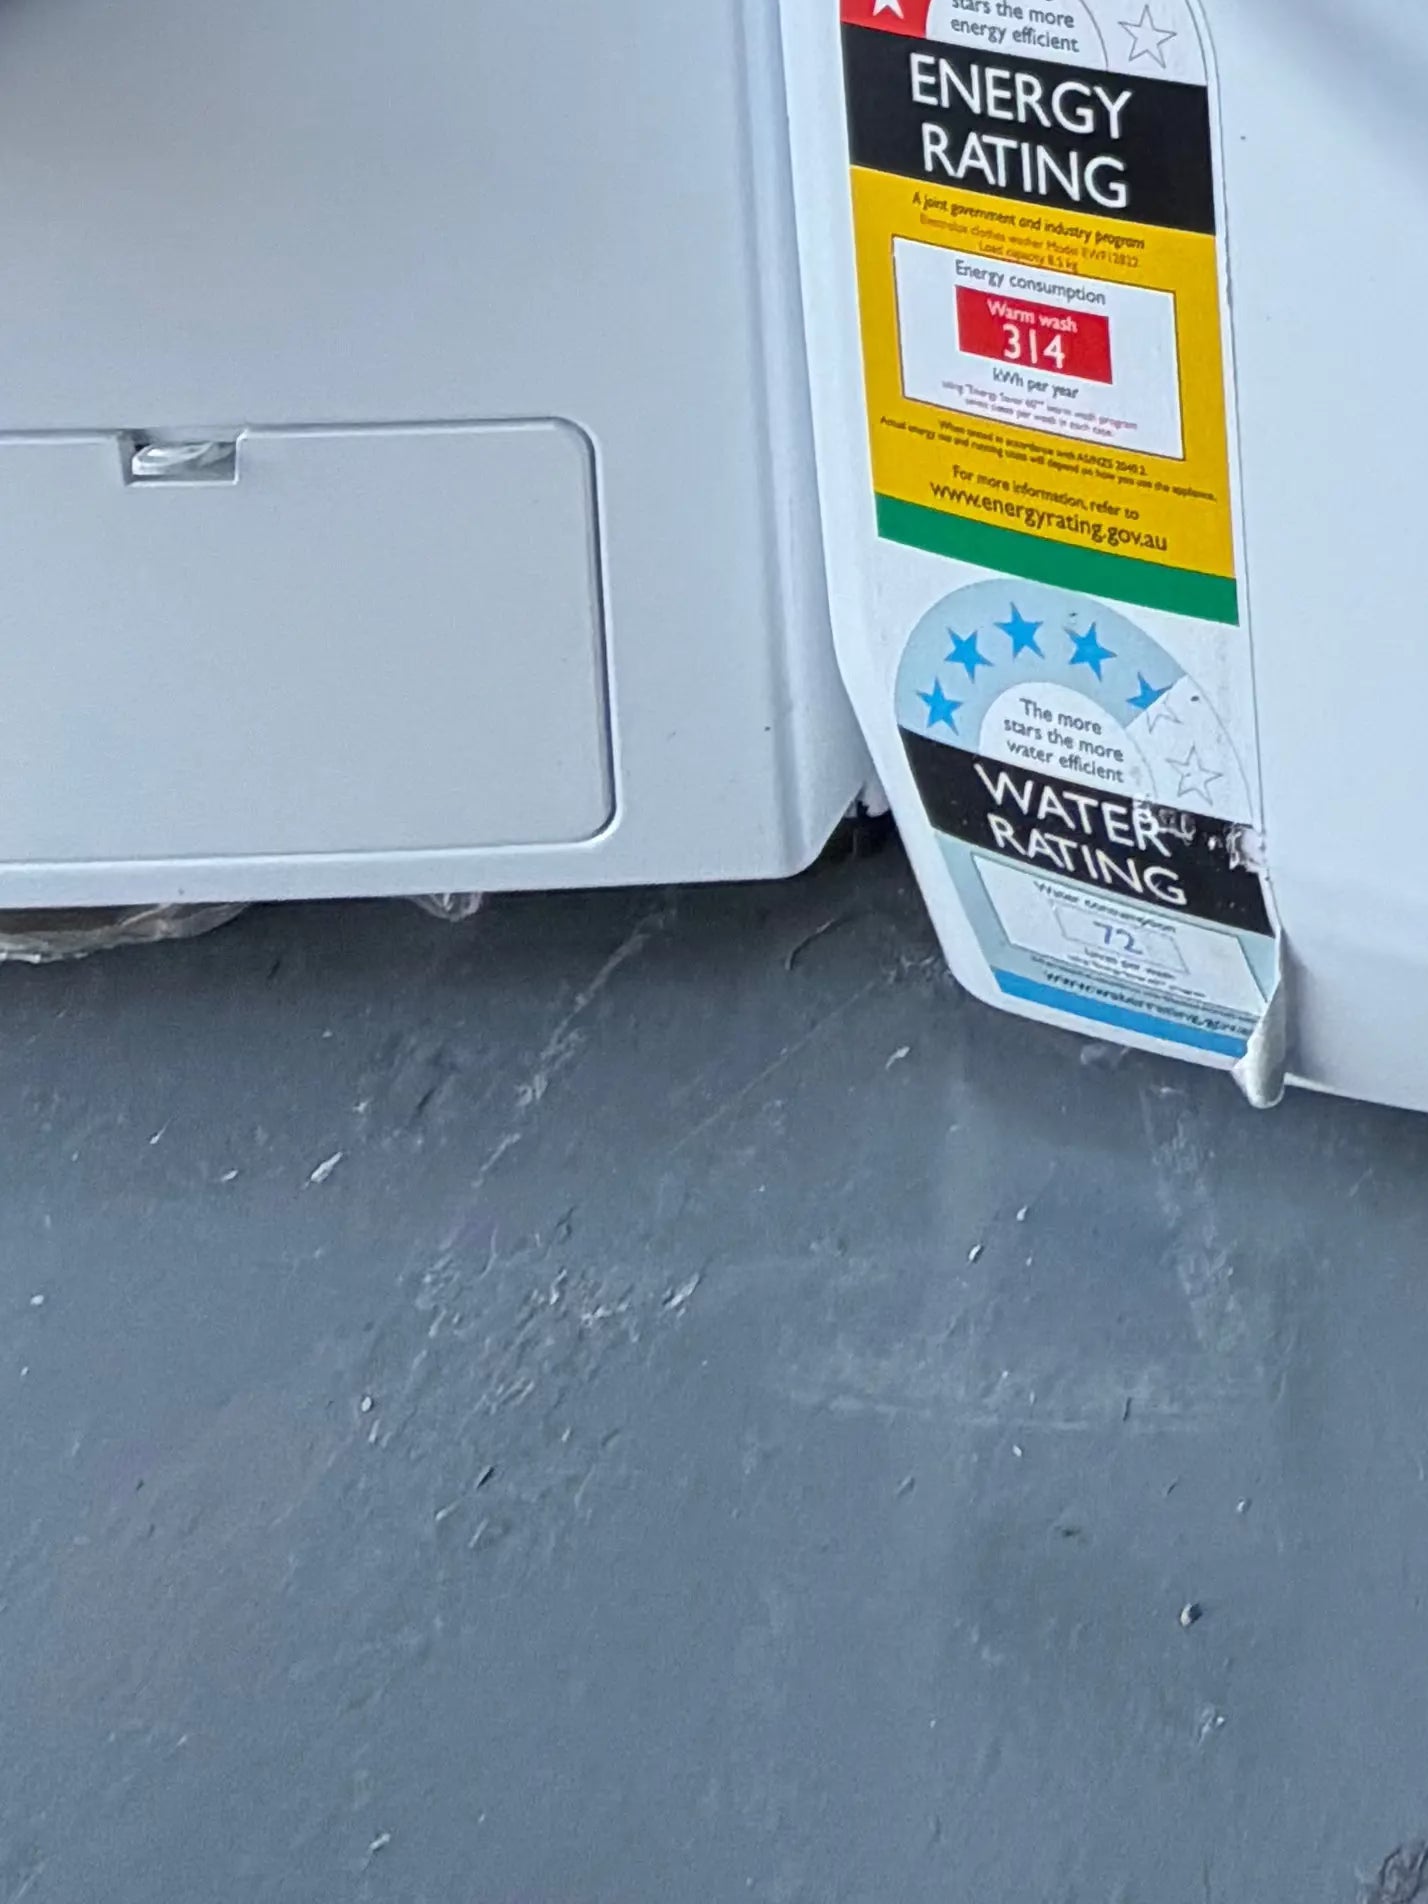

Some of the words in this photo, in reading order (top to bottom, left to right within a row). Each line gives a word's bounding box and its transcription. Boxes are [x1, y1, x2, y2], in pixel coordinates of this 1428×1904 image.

[950, 15, 1008, 47] energy
[1011, 25, 1080, 54] efficient
[1031, 6, 1075, 30] more
[909, 52, 1132, 142] ENERGY
[921, 122, 1129, 210] RATING
[912, 191, 921, 205] A
[923, 193, 948, 212] joint
[950, 199, 1017, 228] government
[1019, 215, 1041, 232] and
[1044, 220, 1092, 244] industry
[1094, 228, 1146, 251] program
[955, 258, 1004, 288] Energy
[1009, 272, 1107, 307] consumption
[987, 297, 1035, 326] Warm
[1038, 310, 1079, 334] wash
[1003, 323, 1066, 370] 314
[992, 366, 1024, 389] kWh
[1027, 376, 1050, 394] per
[1052, 383, 1080, 400] year
[952, 464, 975, 483] For
[976, 472, 1010, 493] more
[1012, 478, 1088, 511] information,
[1090, 498, 1122, 519] refer
[1124, 507, 1140, 521] to
[930, 481, 1168, 552] www.energyrating.gov.au
[1019, 696, 1053, 725] The
[1057, 711, 1103, 736] more
[1003, 717, 1044, 742] stars
[1047, 726, 1074, 750] the
[1078, 736, 1125, 763] more
[1006, 739, 1054, 764] water
[1058, 750, 1124, 784] efficient
[973, 761, 1174, 858] WATER
[987, 816, 1188, 908] RATING
[1092, 919, 1144, 956] 72
